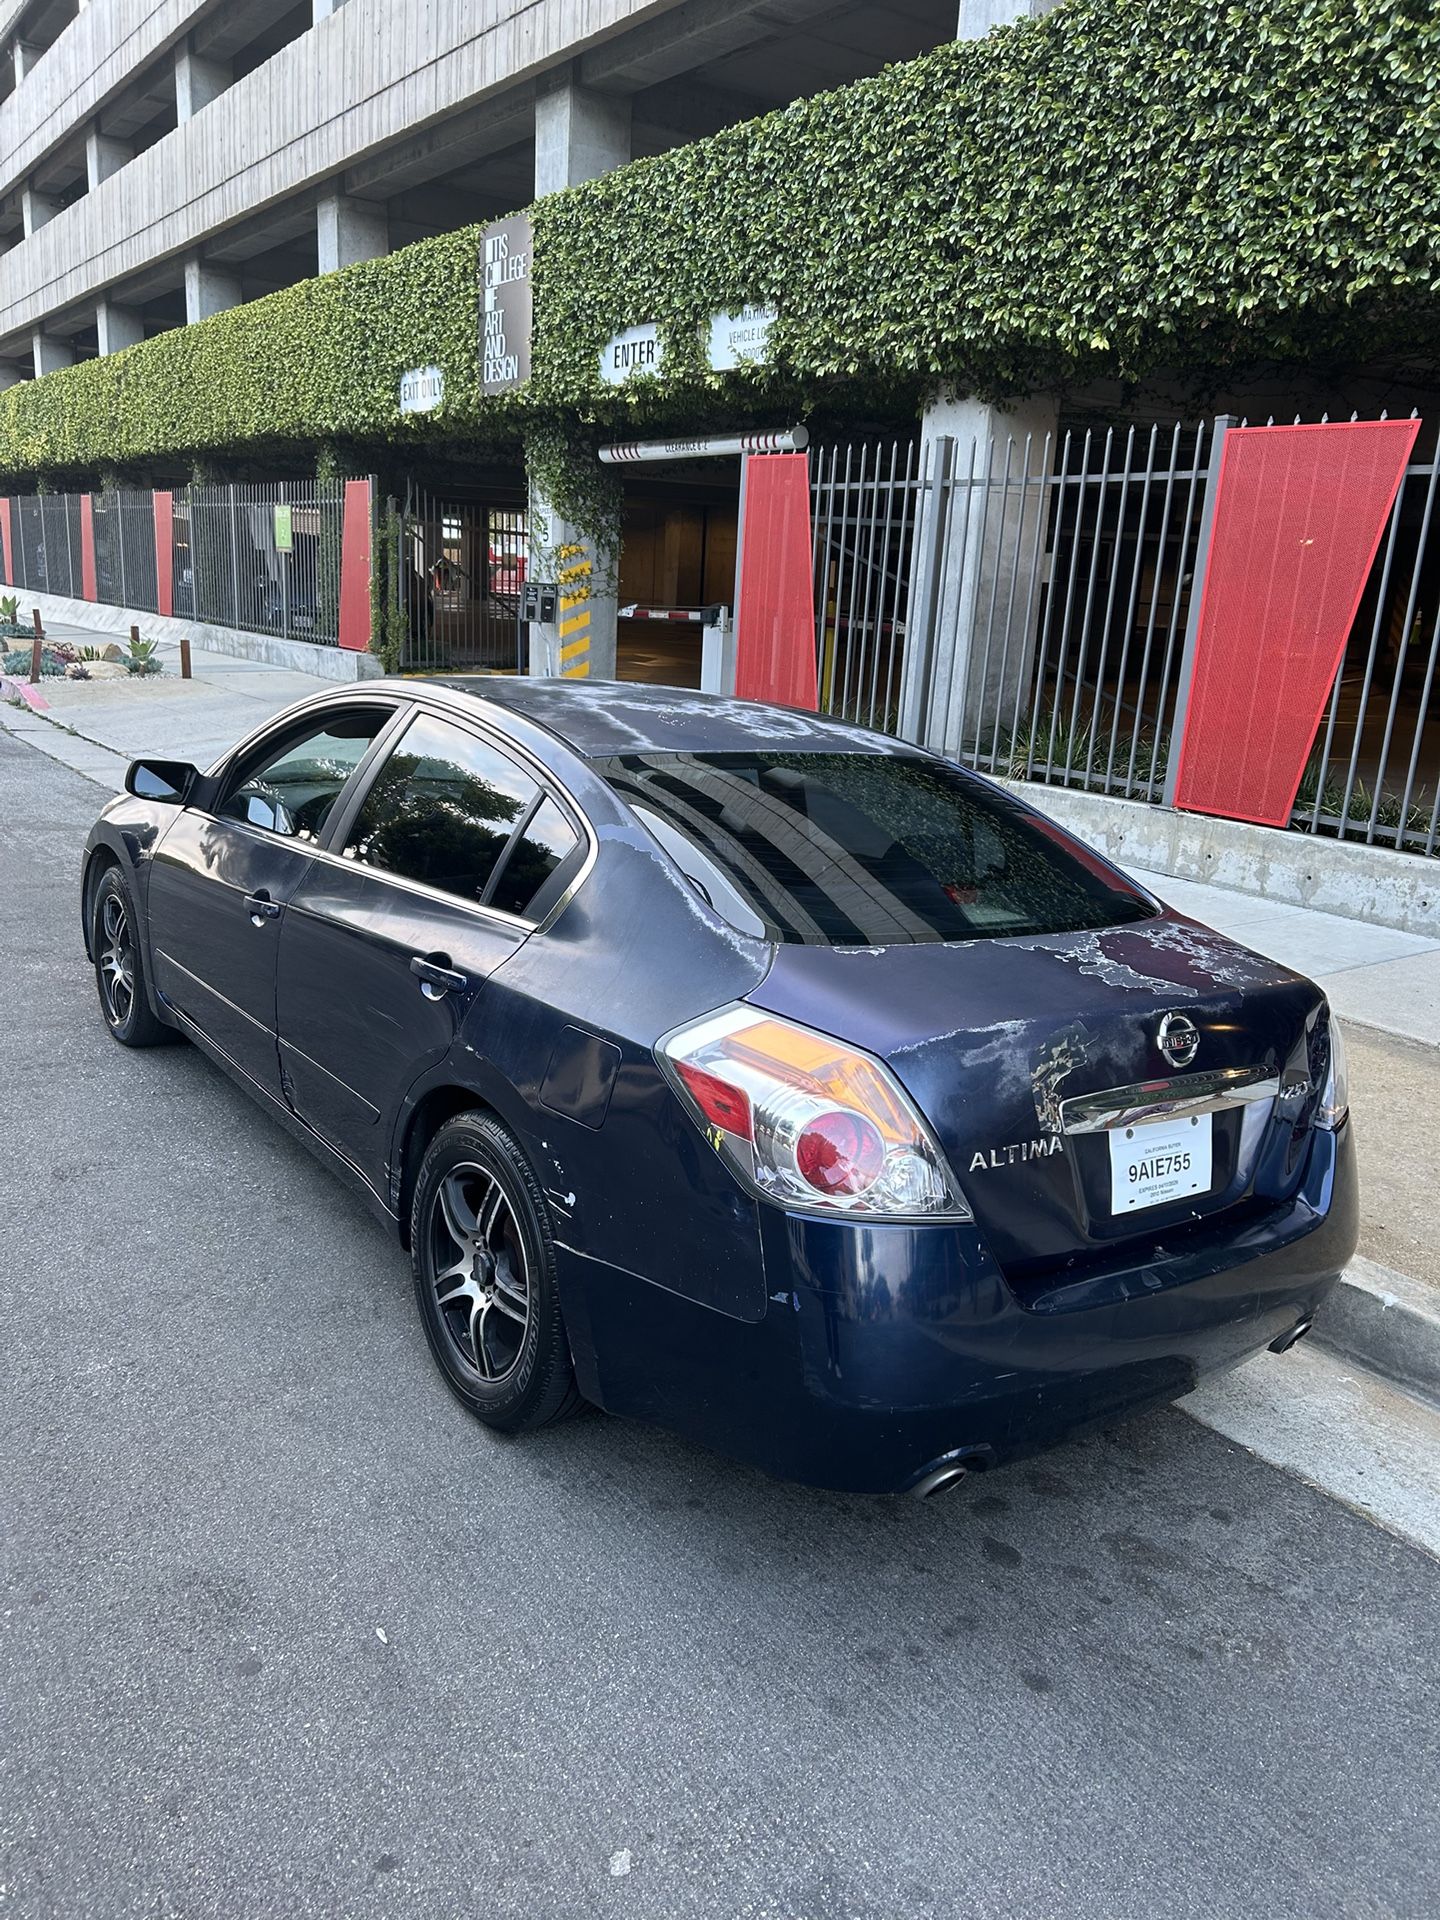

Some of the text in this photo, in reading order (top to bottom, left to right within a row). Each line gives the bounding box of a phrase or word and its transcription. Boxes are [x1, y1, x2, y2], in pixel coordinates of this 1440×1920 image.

[484, 309, 505, 337] ART
[729, 328, 755, 345] VEHICLE
[484, 333, 506, 360] AND
[614, 339, 655, 369] ENTER
[484, 354, 518, 384] DESIGN
[403, 377, 442, 401] EXIT ONLY
[543, 527, 550, 542] 5
[968, 1135, 1064, 1173] ALTIMA
[1128, 1152, 1191, 1183] 9AIE755
